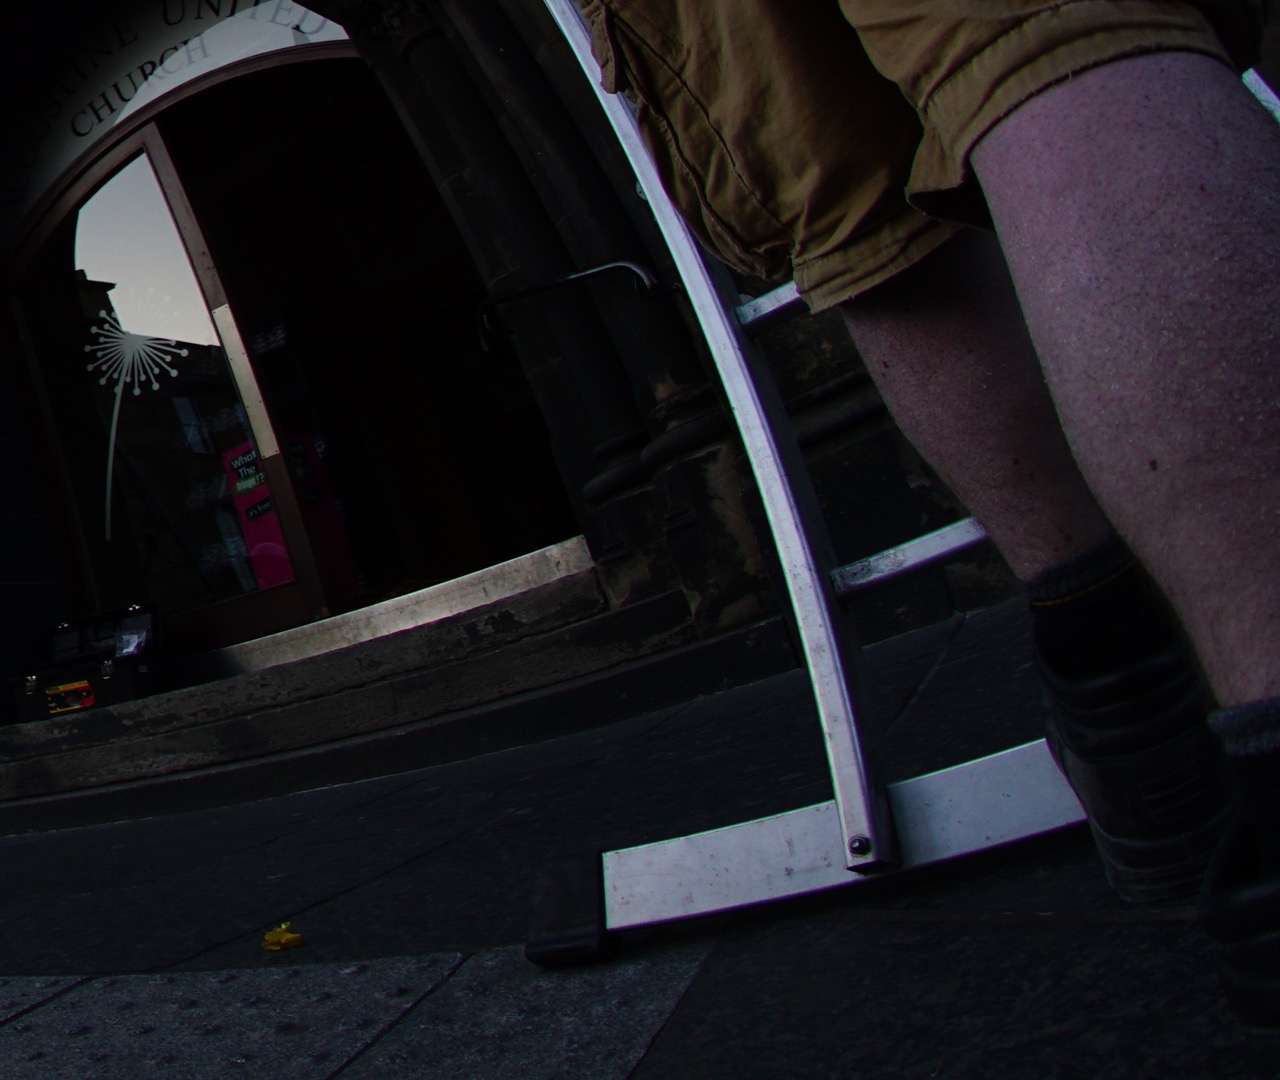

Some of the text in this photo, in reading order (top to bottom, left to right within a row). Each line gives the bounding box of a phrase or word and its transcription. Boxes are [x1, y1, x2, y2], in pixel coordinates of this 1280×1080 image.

[69, 32, 210, 138] CHURCH
[230, 449, 257, 469] What
[237, 465, 256, 478] The
